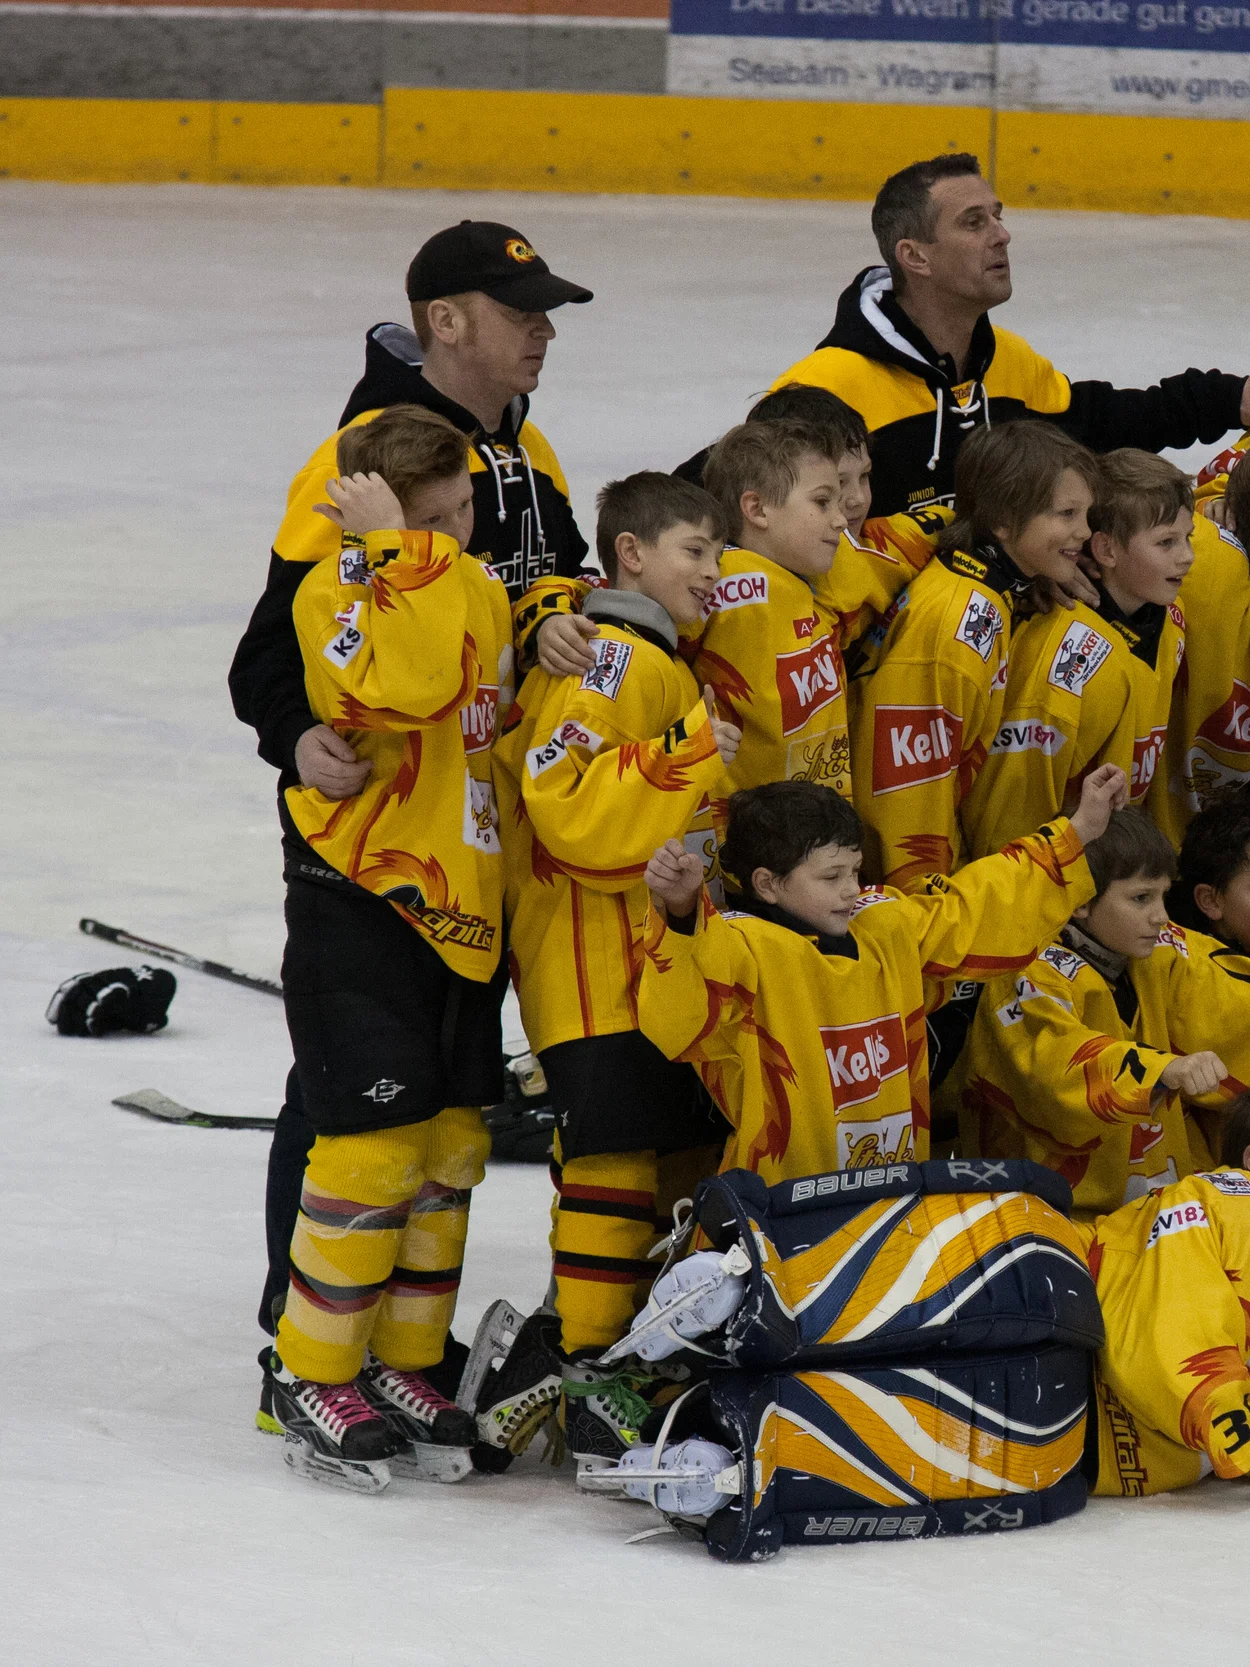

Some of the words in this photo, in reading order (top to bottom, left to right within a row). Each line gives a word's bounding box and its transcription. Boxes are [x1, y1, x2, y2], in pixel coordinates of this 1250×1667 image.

[1137, 2, 1187, 31] gut
[907, 486, 935, 503] JUNIOR
[461, 694, 496, 742] lly's
[890, 717, 954, 768] Kell
[792, 1165, 909, 1202] BAUER
[803, 1515, 927, 1536] BAUER
